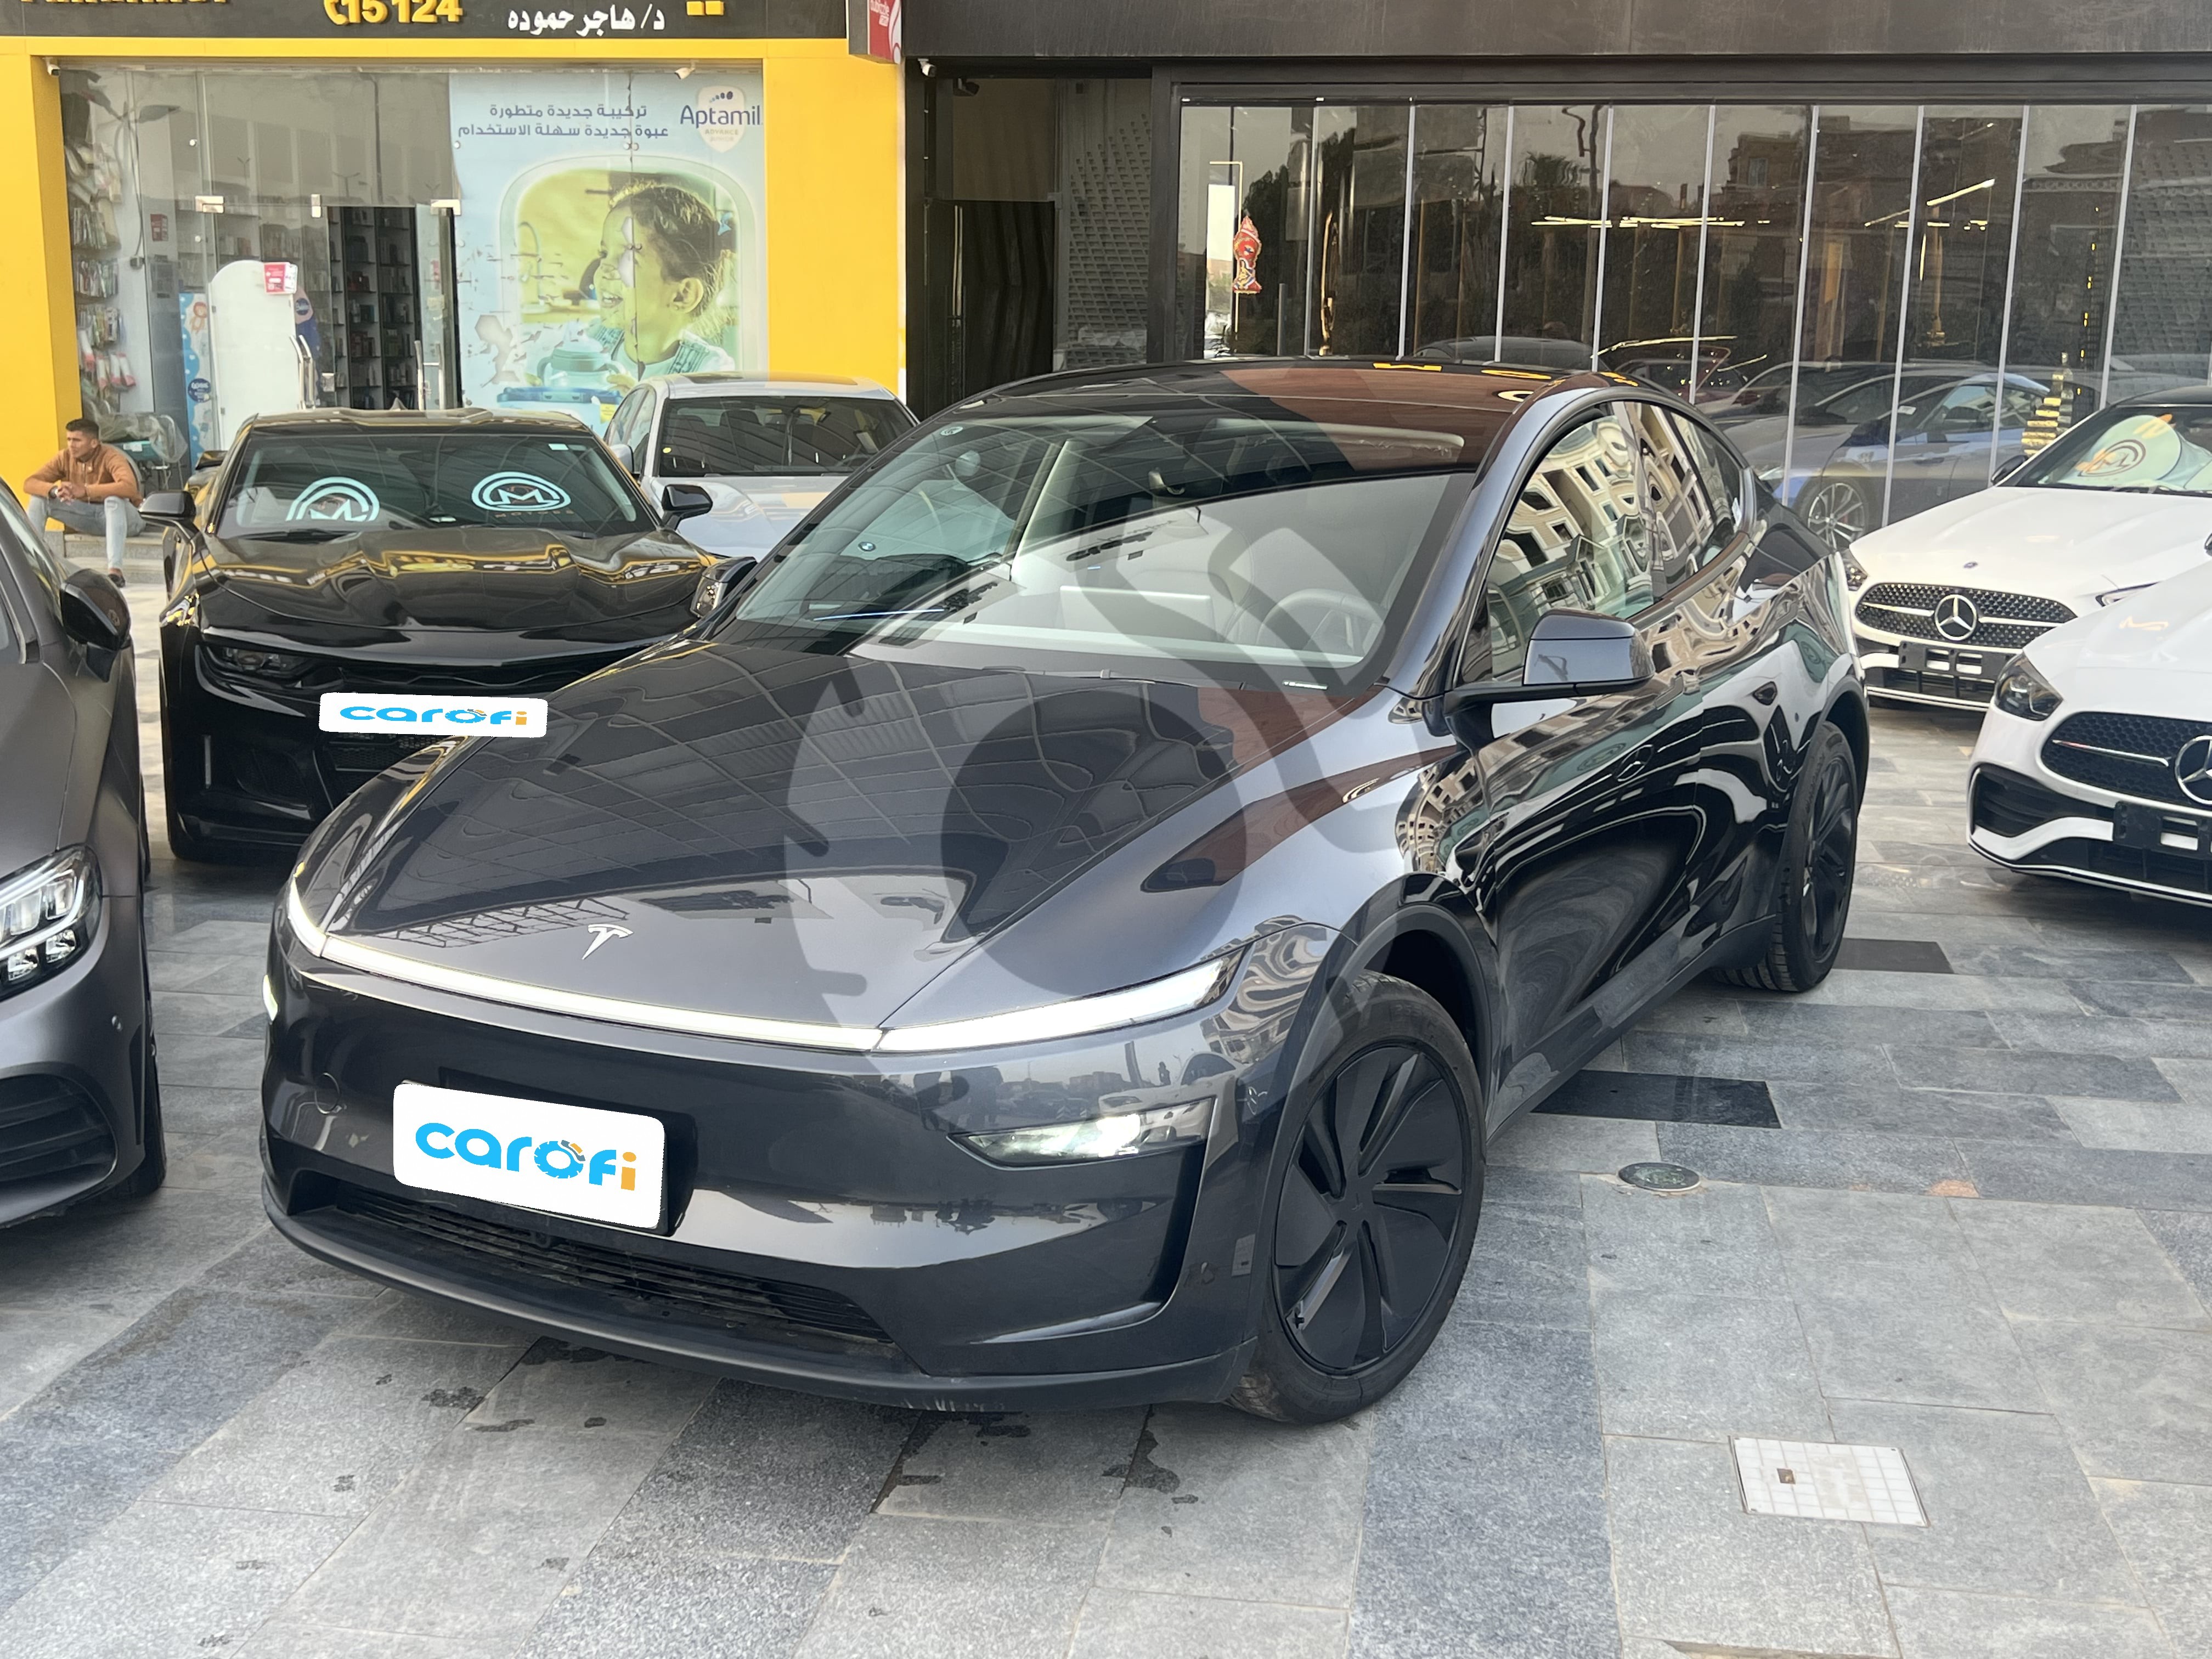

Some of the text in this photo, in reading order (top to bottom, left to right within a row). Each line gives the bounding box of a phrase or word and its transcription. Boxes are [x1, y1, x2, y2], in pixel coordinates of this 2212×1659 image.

[341, 0, 463, 23] 15124
[576, 4, 635, 37] هاجر
[490, 104, 646, 119] تركيبة جديدة متطورة
[680, 105, 760, 128] Aptamil
[458, 123, 668, 139] عبوة جديدة سهلة الاستخدام
